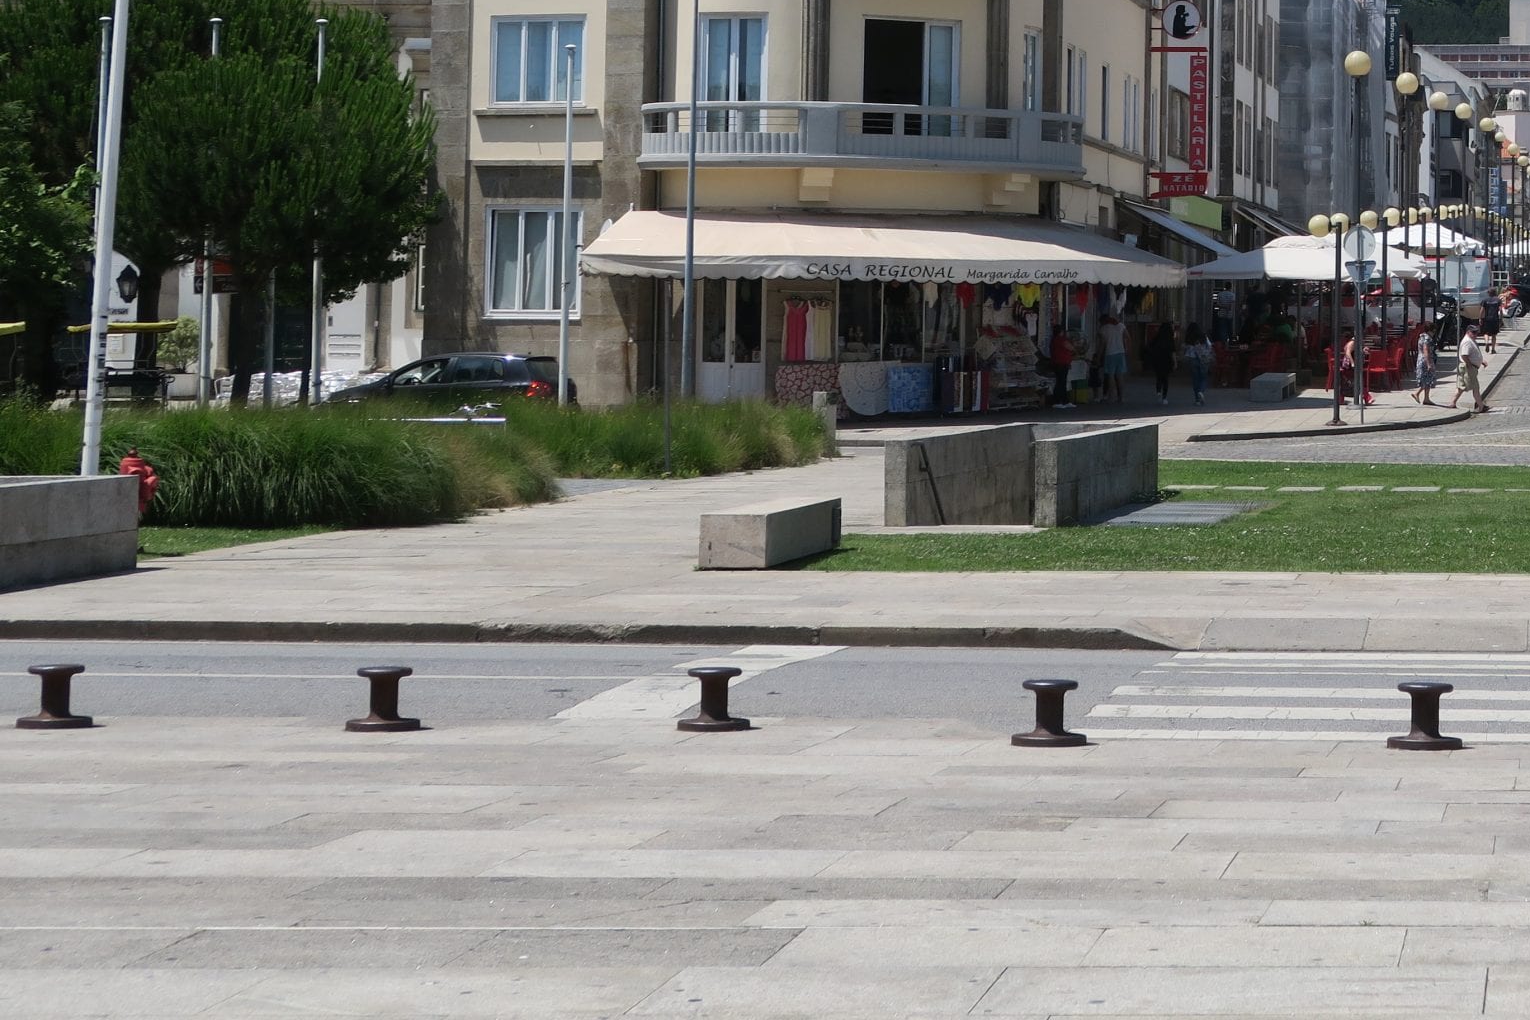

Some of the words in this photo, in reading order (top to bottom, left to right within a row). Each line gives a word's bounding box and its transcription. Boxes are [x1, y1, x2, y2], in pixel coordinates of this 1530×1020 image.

[1192, 58, 1204, 169] PASTELARIA
[806, 262, 853, 277] CASA
[864, 263, 956, 279] REGIONAL
[966, 267, 1030, 281] Margarida
[1034, 268, 1079, 280] Carvalho
